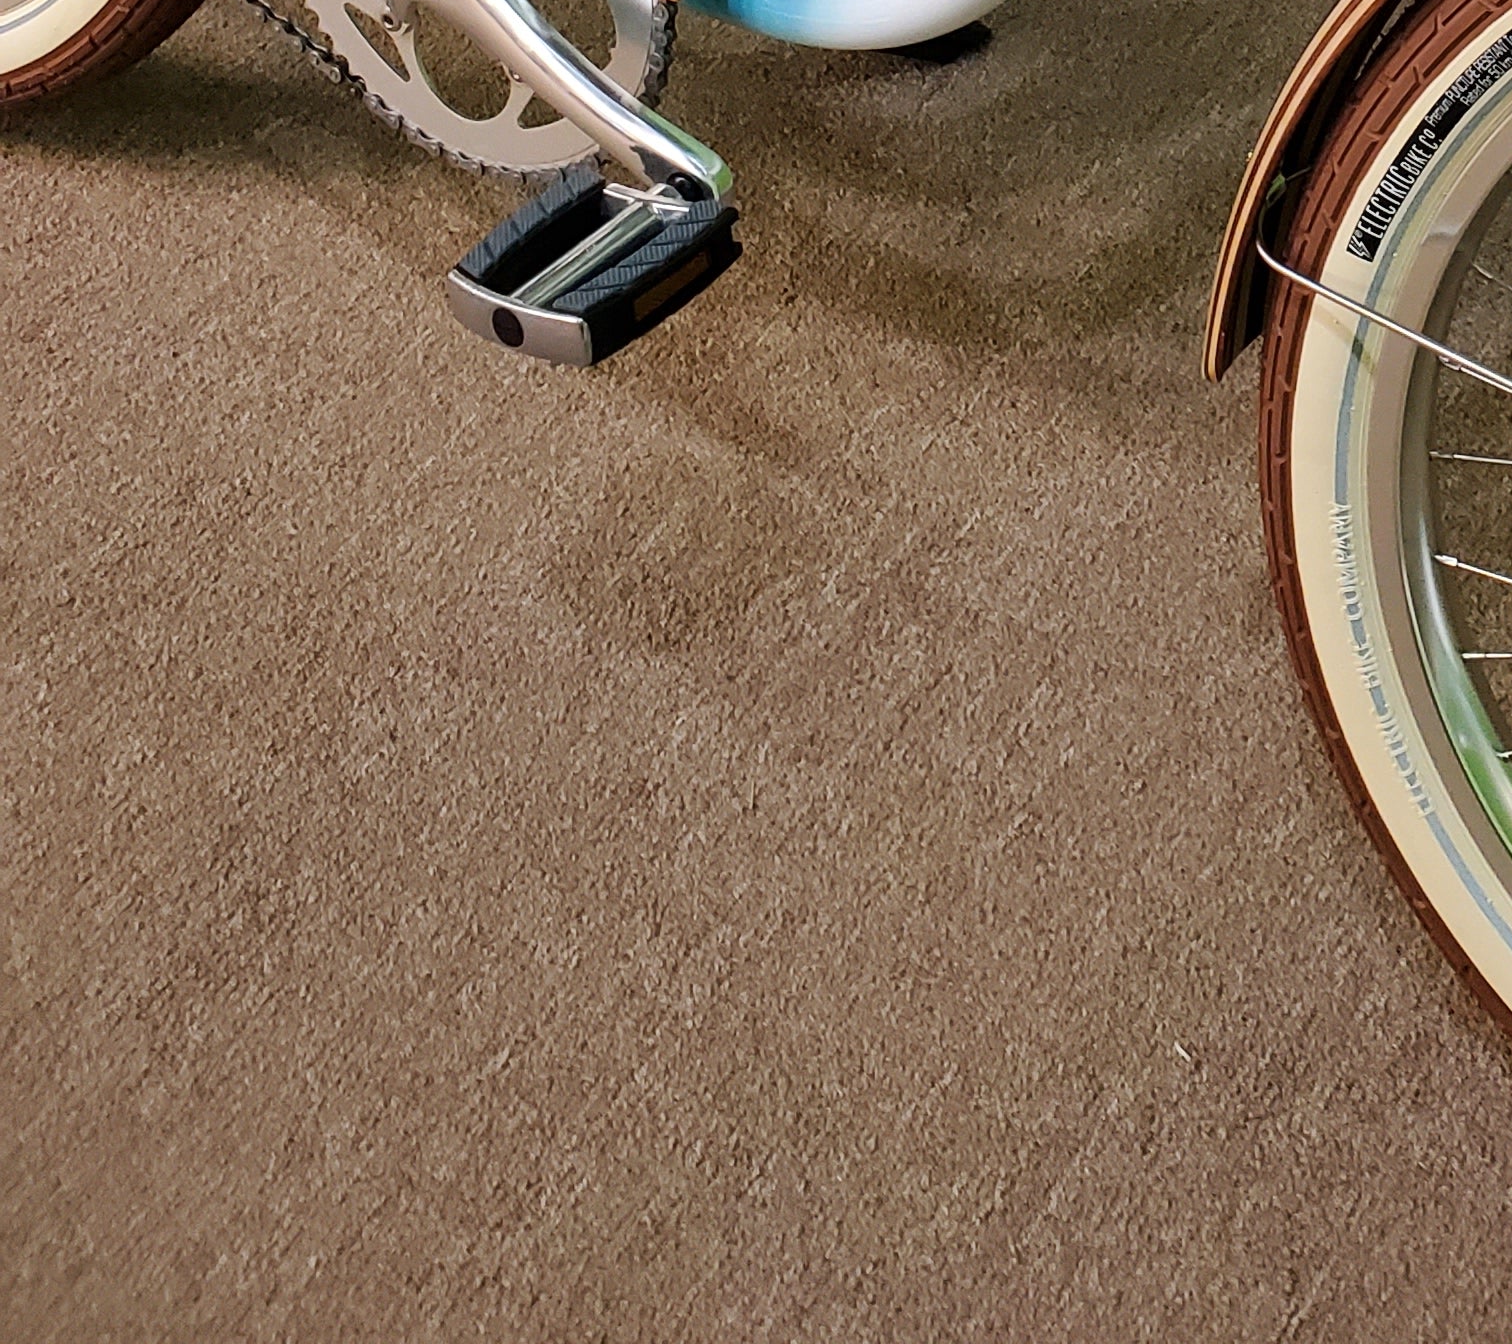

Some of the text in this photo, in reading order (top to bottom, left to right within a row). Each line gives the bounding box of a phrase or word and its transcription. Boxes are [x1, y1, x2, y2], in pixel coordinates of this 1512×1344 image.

[1424, 97, 1453, 127] Premium
[1445, 66, 1480, 102] PUNCTURE
[1460, 84, 1485, 107] Rated
[1479, 75, 1494, 88] for
[1488, 64, 1503, 79] 50
[1358, 165, 1415, 239] ELECTRIC
[1400, 144, 1433, 176] BIKE
[1329, 502, 1362, 622] COMPANY
[1349, 634, 1381, 692] BIKE
